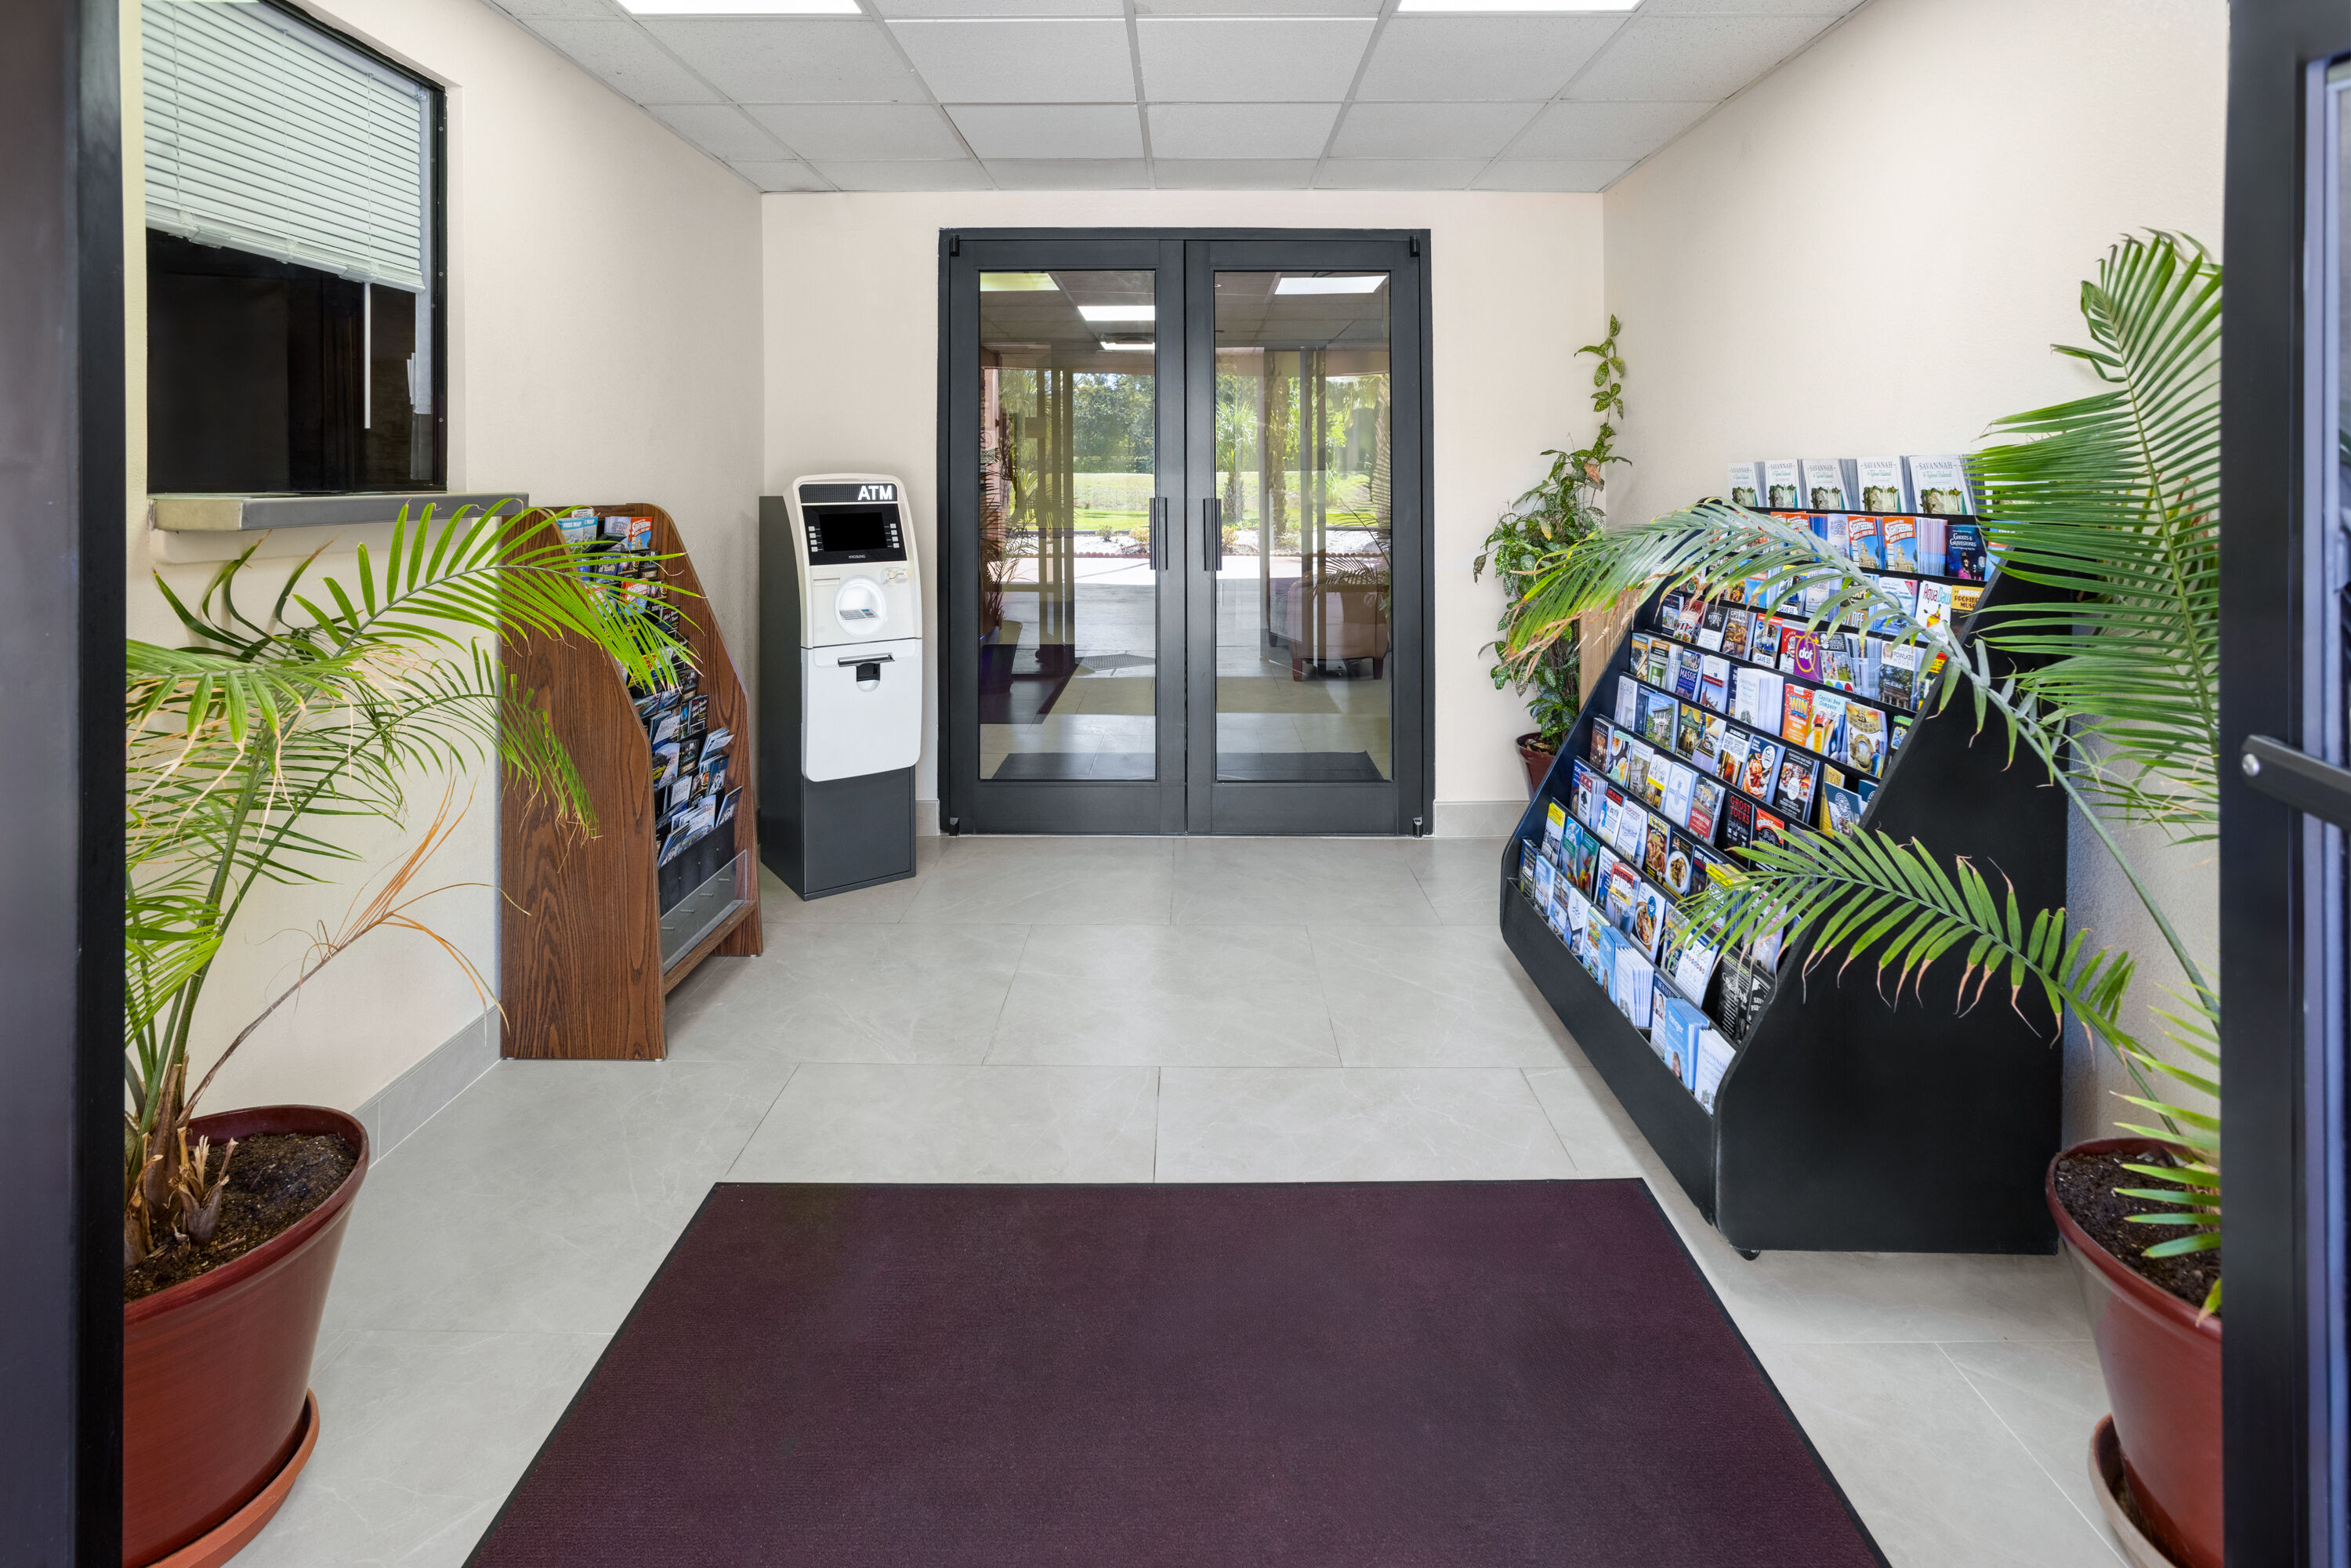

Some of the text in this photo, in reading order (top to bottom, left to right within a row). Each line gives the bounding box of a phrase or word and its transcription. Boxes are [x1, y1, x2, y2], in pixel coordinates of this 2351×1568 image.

[1864, 461, 1893, 469] SAVANNAH
[857, 484, 893, 501] ATM
[1950, 538, 1976, 547] GRAVESTONES
[1851, 611, 1864, 627] OFF
[1757, 654, 1766, 663] SAVE
[1799, 647, 1813, 660] dot
[1679, 668, 1697, 683] MASSIE
[1619, 682, 1633, 694] SCAD
[1818, 694, 1832, 703] Capital
[1819, 701, 1838, 711] Company
[1789, 696, 1808, 718] WIN
[1730, 795, 1751, 814] GHOST
[1730, 805, 1750, 824] TOURS
[1614, 867, 1634, 888] ADVENTURE
[1613, 874, 1632, 897] GUIDE
